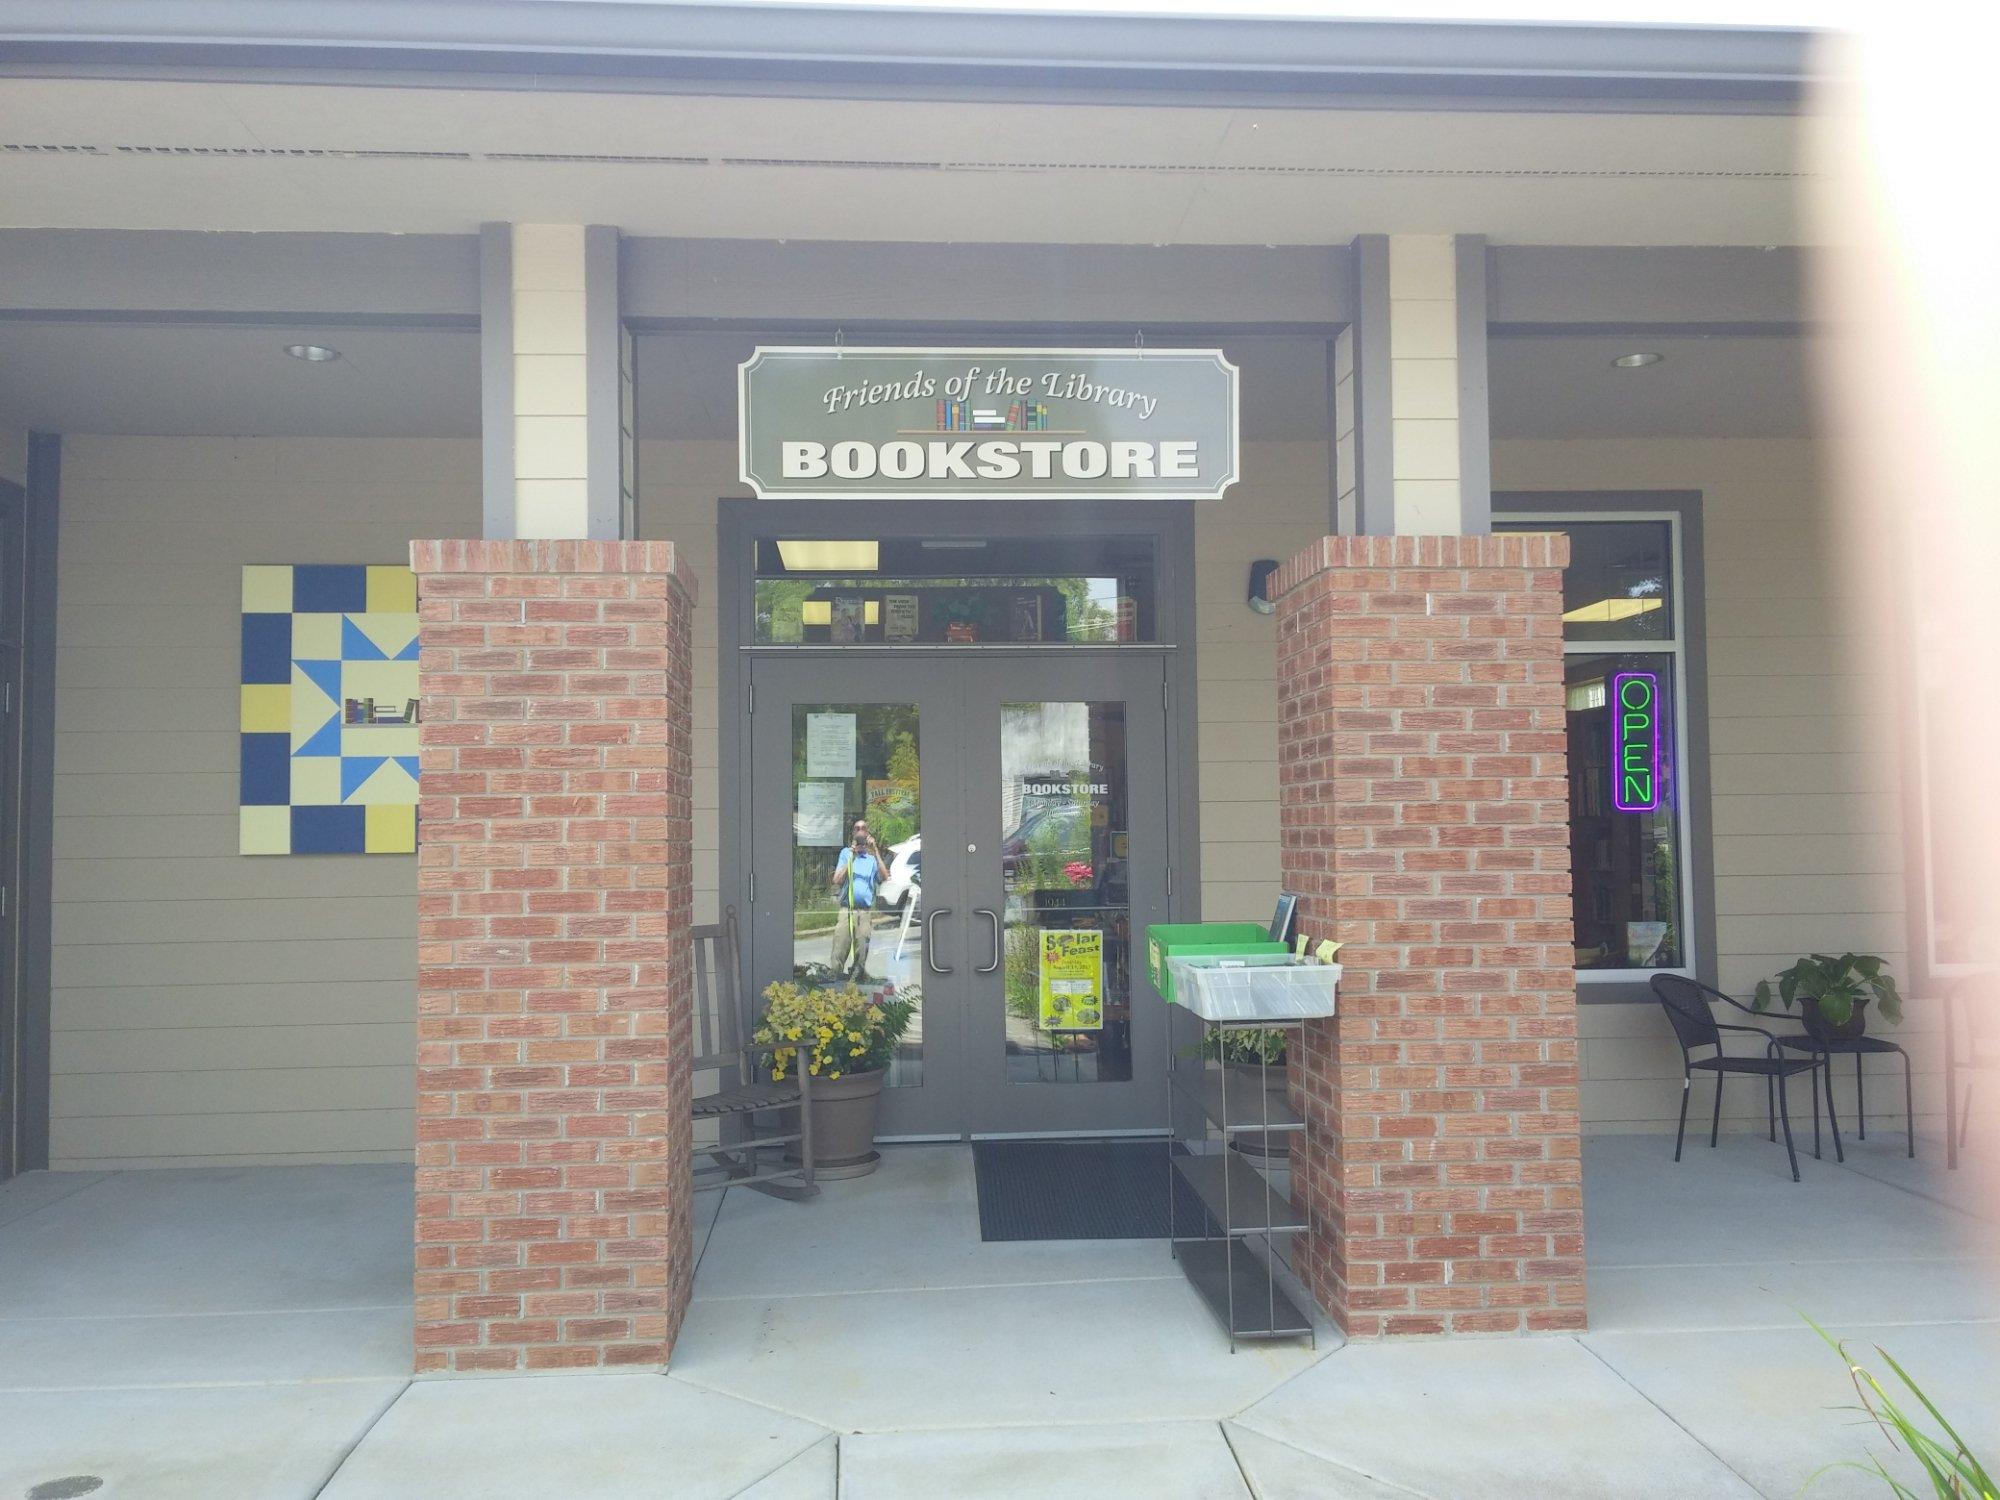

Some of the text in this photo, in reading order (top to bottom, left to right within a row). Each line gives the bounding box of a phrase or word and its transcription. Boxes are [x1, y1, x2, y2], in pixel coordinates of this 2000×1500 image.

[822, 366, 1158, 420] Friends of the Library
[782, 440, 1200, 480] BOOKSTORE
[1621, 680, 1651, 803] OPEN
[1022, 783, 1109, 795] BOOKSTORE
[1046, 933, 1098, 951] Solar
[1062, 945, 1100, 957] Feast
